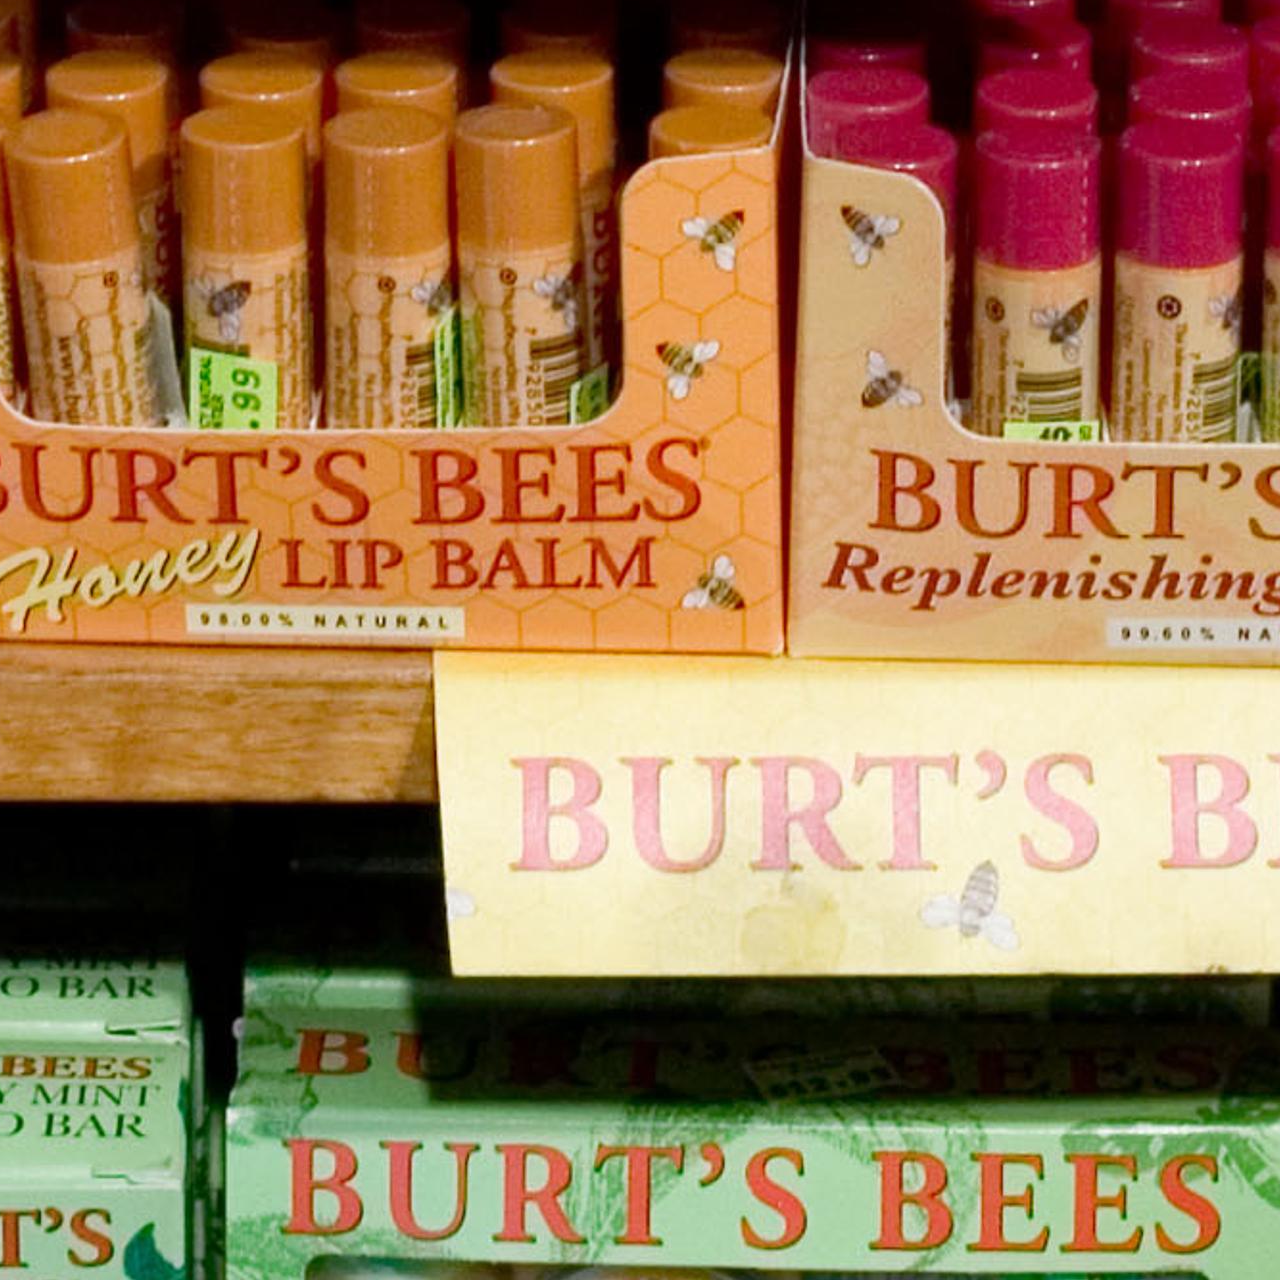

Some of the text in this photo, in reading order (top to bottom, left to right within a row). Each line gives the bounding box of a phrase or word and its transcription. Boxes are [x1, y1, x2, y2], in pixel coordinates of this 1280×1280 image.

[410, 439, 701, 524] BEES
[282, 540, 405, 589] LIP
[430, 537, 657, 590] BALM
[314, 614, 448, 630] NATURAL
[508, 753, 1100, 872] BURT'S
[31, 1081, 162, 1108] MINT
[43, 1113, 147, 1138] BAR
[283, 1137, 1225, 1255] BURT'S BEES
